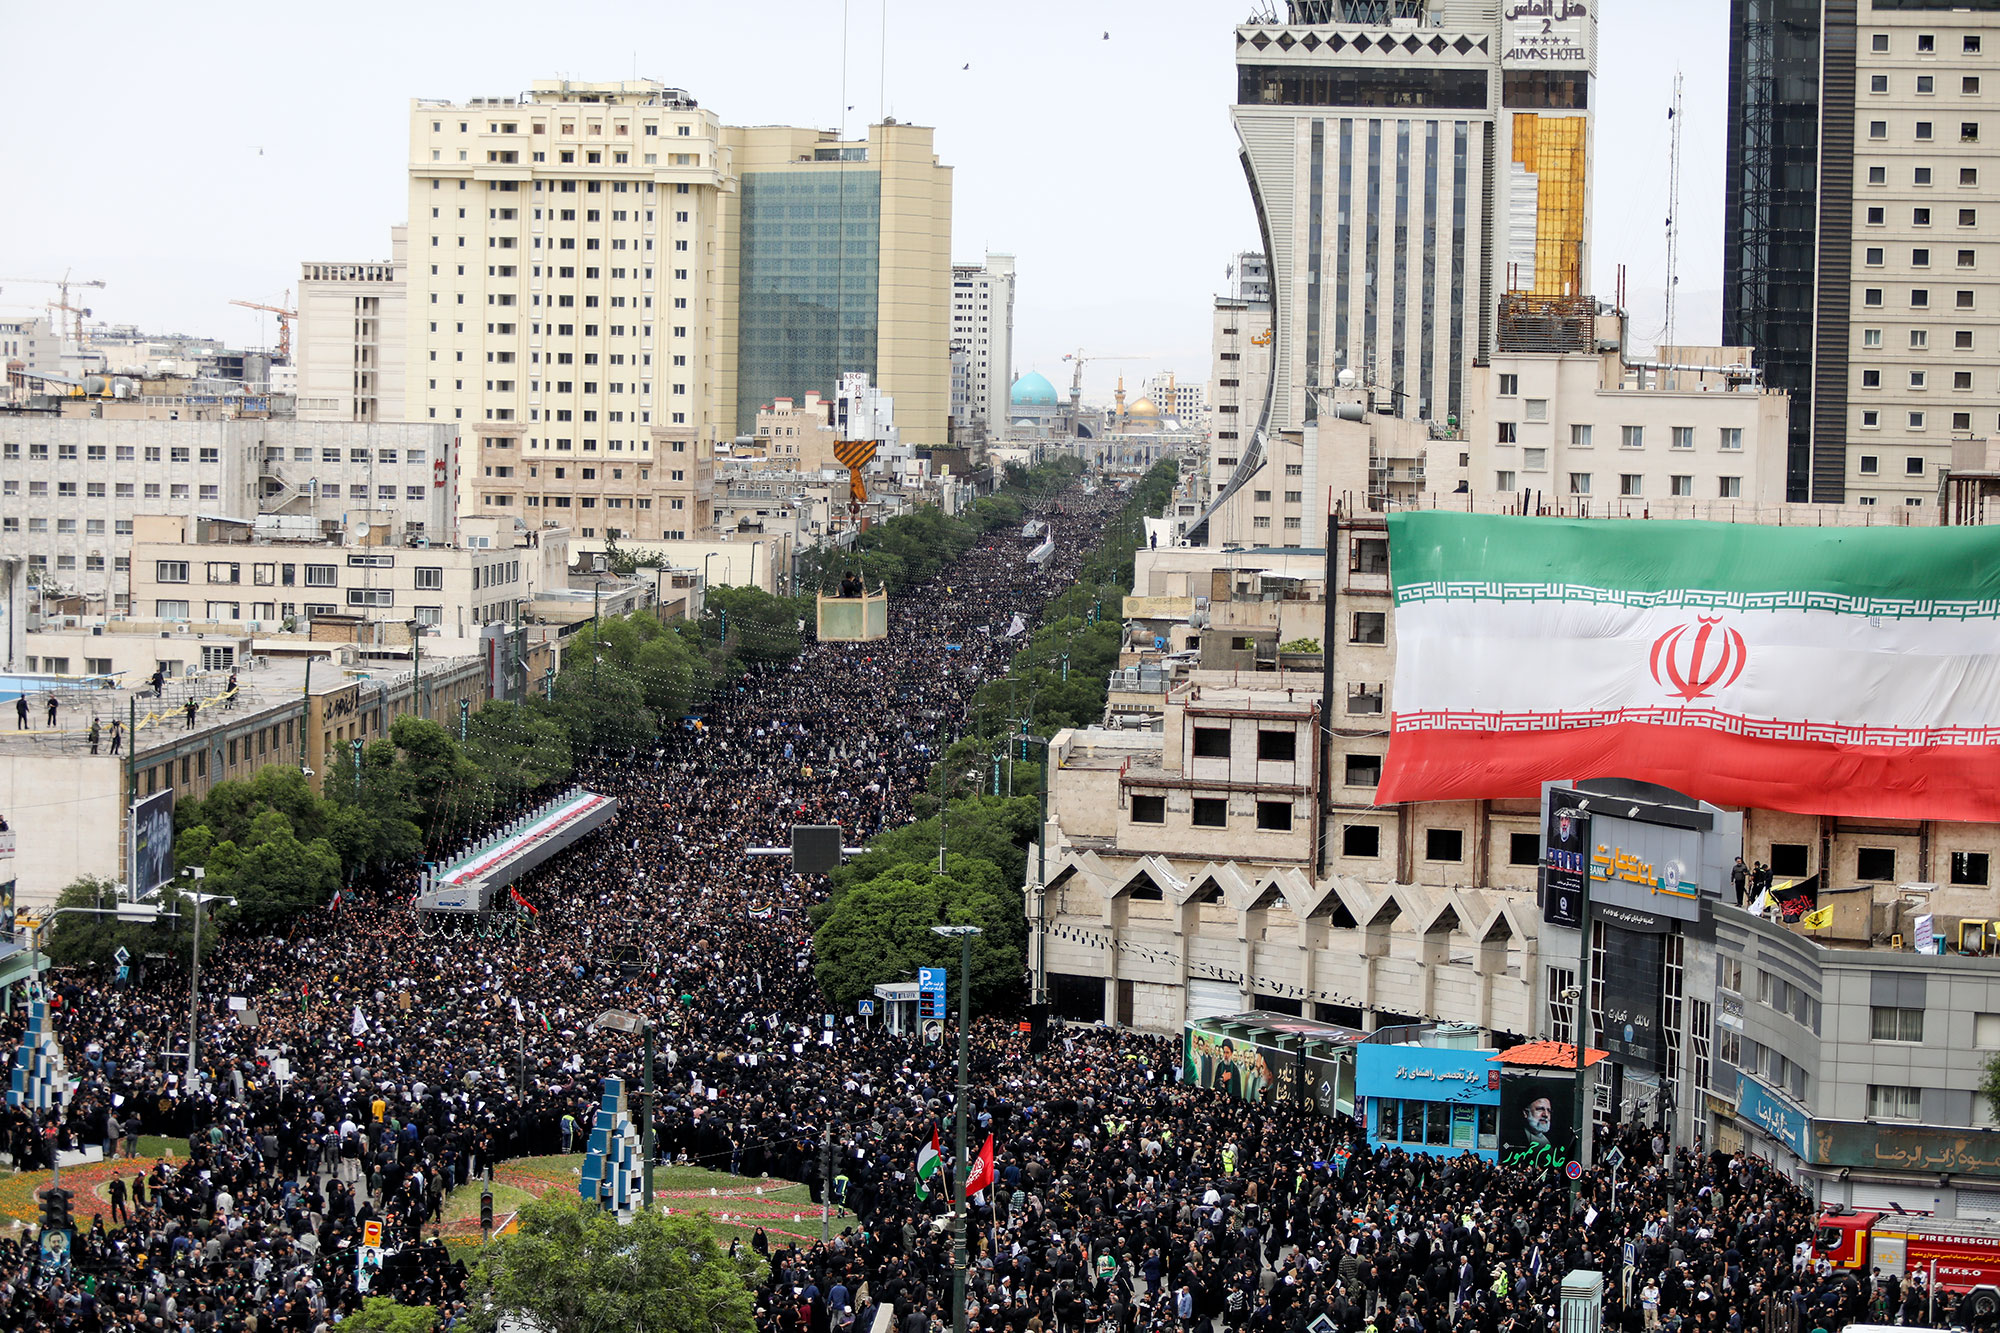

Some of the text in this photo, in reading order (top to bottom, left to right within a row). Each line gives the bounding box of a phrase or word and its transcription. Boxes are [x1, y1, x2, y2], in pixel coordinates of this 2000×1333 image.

[1503, 48, 1586, 60] ALMAS HOTEL
[920, 970, 932, 986] P
[1395, 1066, 1479, 1083] مرکز تخصصی راهنمای زائر
[1502, 1141, 1566, 1168] خادم جمهور
[1938, 1267, 1982, 1276] M.F.S.O
